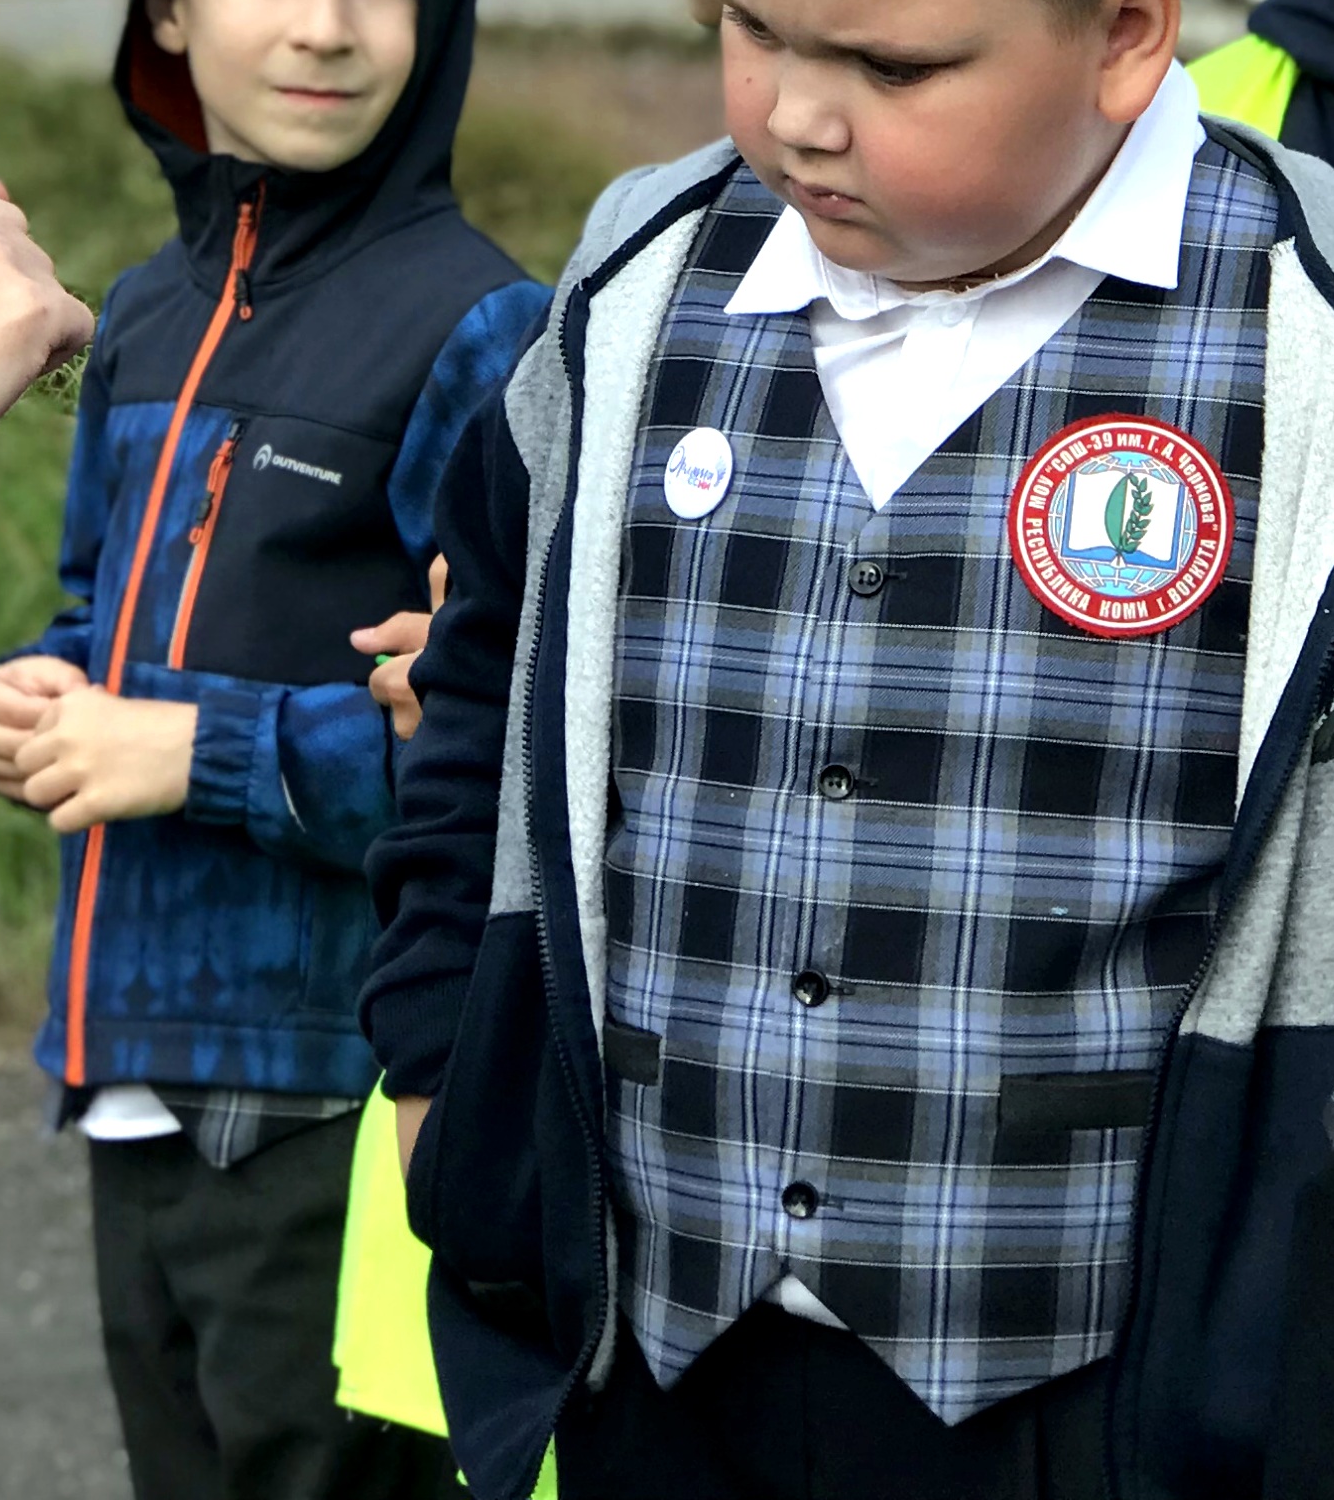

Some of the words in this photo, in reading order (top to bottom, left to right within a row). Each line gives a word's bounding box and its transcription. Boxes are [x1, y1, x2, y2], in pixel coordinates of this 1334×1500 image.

[272, 454, 342, 486] OUTVENTURE
[1028, 474, 1054, 510] МОУ
[1026, 518, 1091, 611] РЕСПУБЛИКА
[1099, 599, 1148, 620] КОМИ
